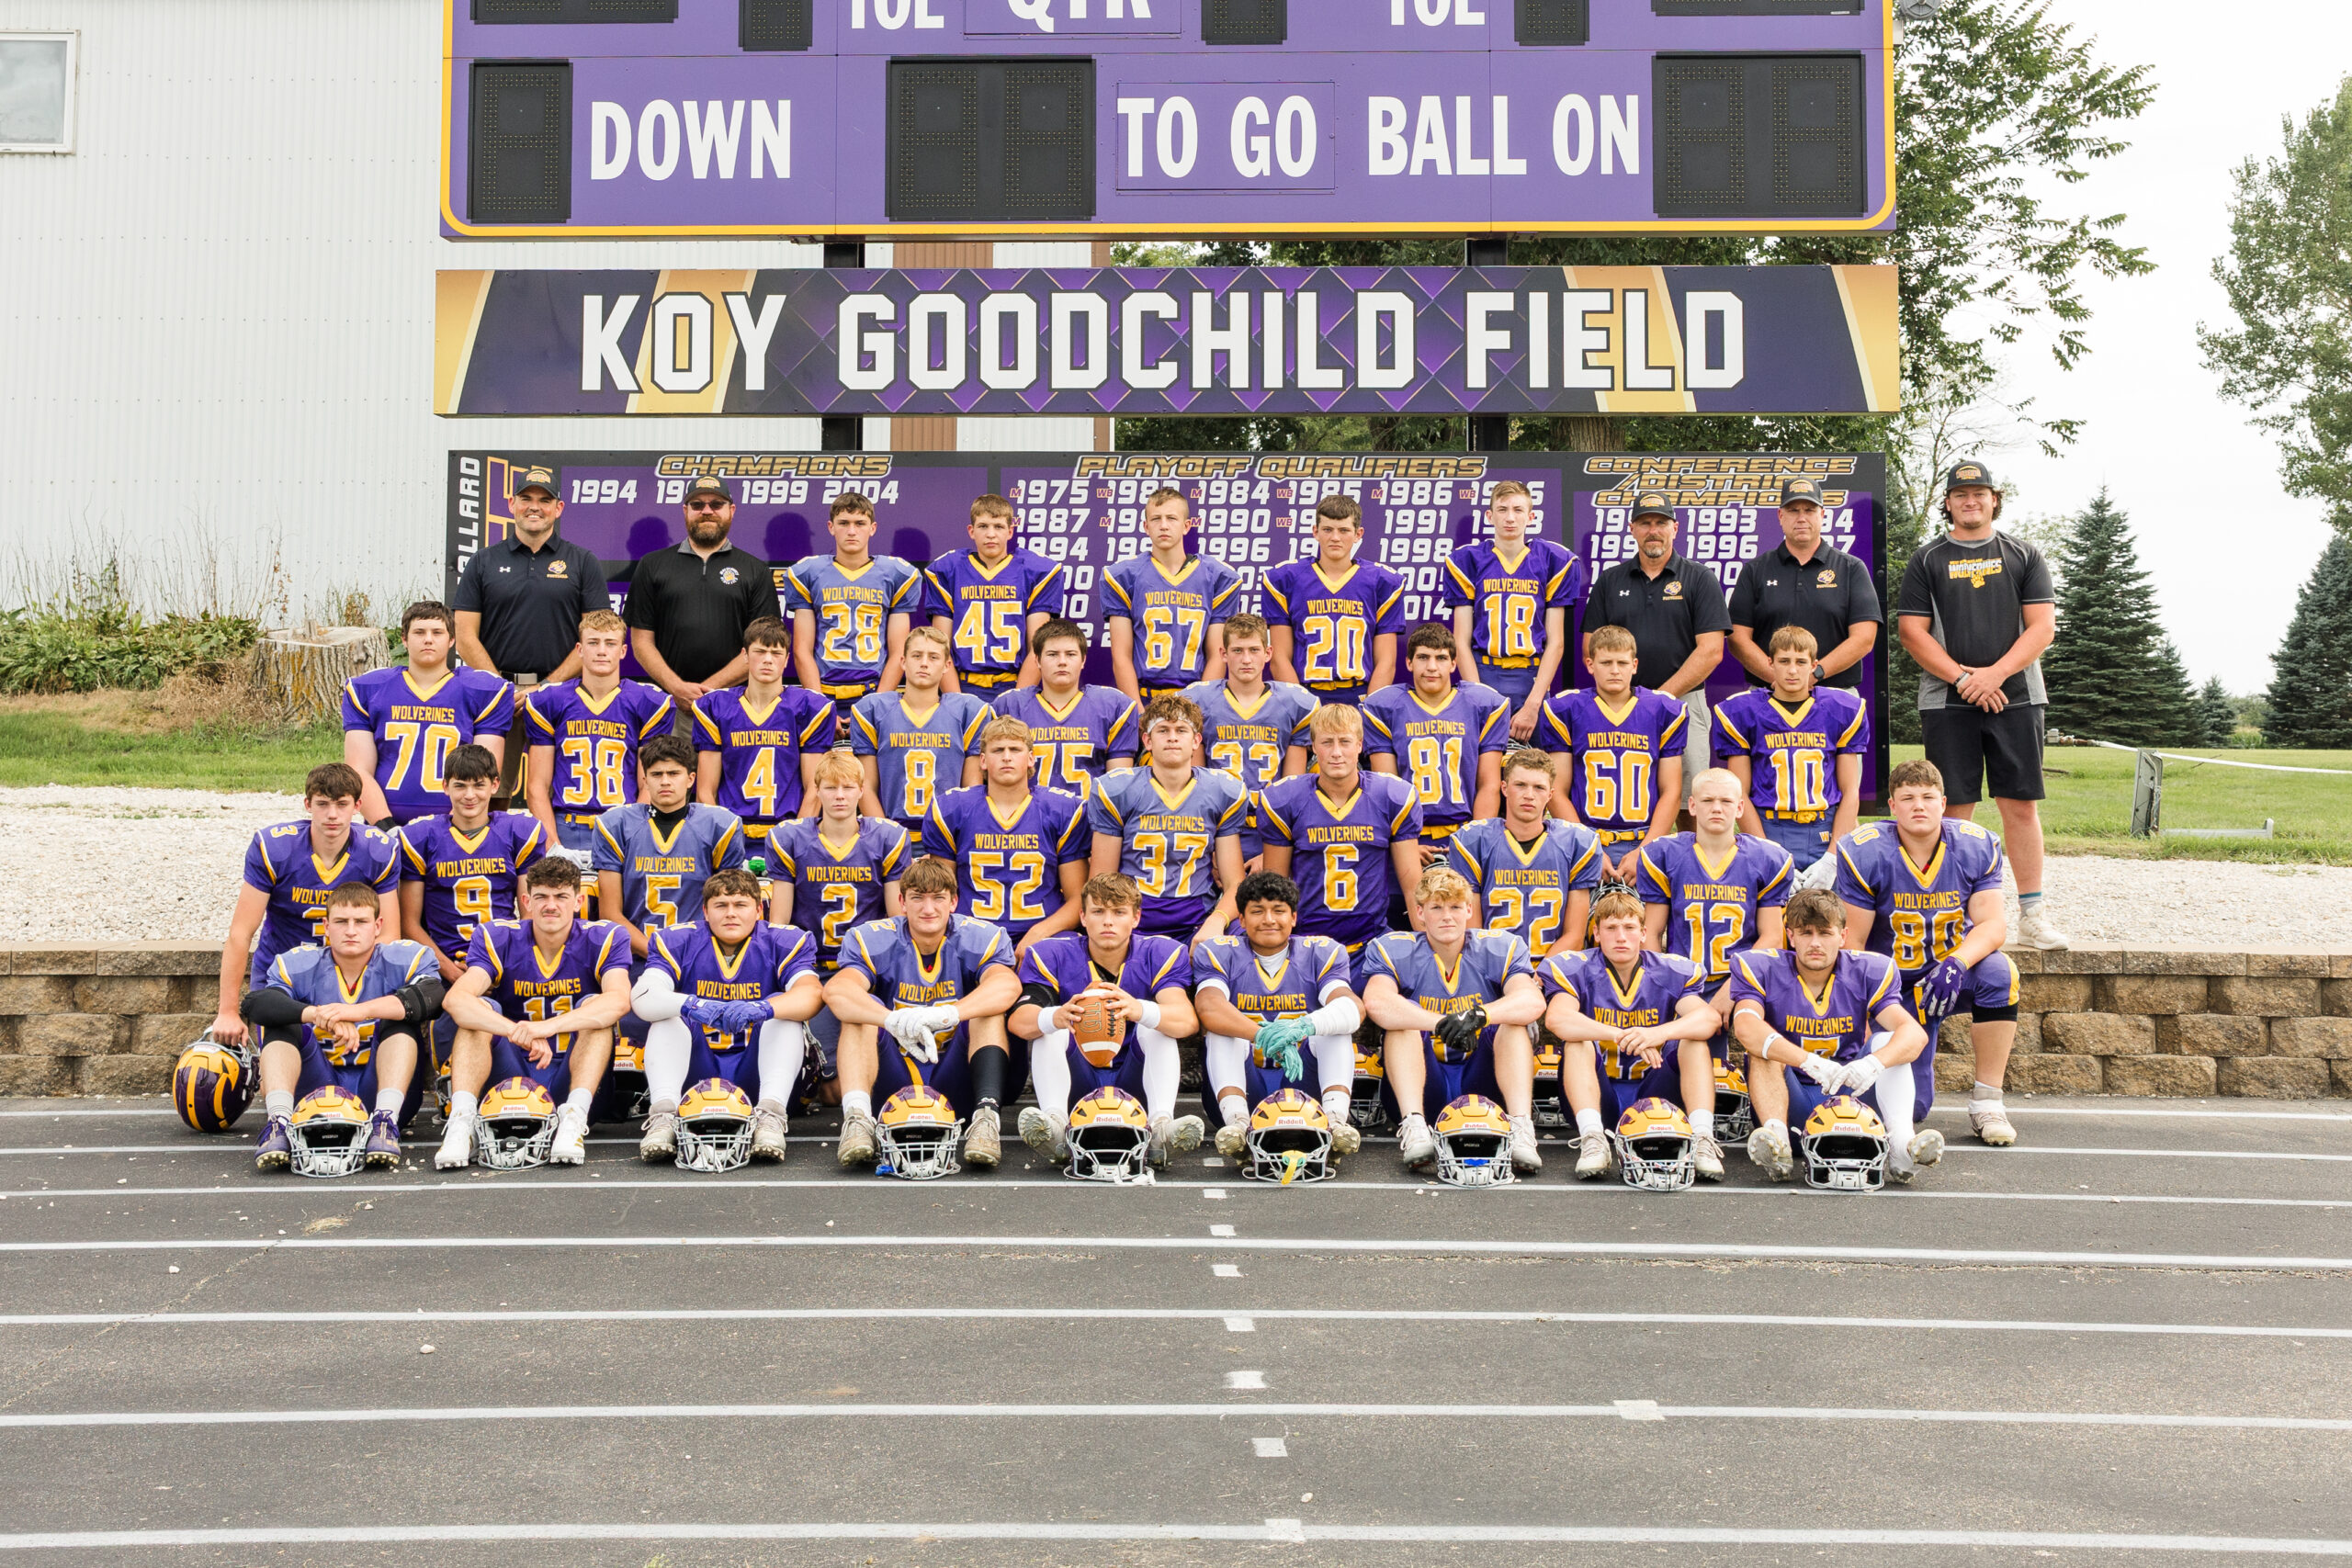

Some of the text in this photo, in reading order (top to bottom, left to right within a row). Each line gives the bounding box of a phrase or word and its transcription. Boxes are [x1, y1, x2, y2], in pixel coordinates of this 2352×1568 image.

[591, 99, 791, 181] DOWN
[1117, 96, 1317, 178] TO GO
[1368, 93, 1639, 175] BALL ON
[581, 289, 1746, 393] KOY GOODCHILD FIELD
[655, 455, 892, 479] CHAMPIONS
[1074, 456, 1488, 481] PLAYOFF QUALIFIERS
[1583, 457, 1857, 474] CONFERENCE
[571, 479, 638, 504] 1994
[741, 480, 808, 504] 1999
[822, 480, 899, 504] 2004
[1017, 479, 1090, 504] 1975
[1198, 480, 1270, 504] 1984
[1379, 480, 1453, 505] 1986
[1017, 508, 1091, 533] 1987
[1198, 509, 1271, 533] 1990
[1385, 510, 1448, 534] 1991
[1687, 509, 1757, 533] 1993
[1198, 537, 1271, 562] 1996
[1379, 538, 1453, 562] 1998
[1590, 535, 1758, 558] 199 1996
[822, 586, 883, 604] WOLVERINES
[961, 585, 1016, 600] WOLVERINES
[1483, 578, 1539, 594] WOLVERINES
[1145, 592, 1203, 607] WOLVERINES
[1306, 599, 1363, 615] WOLVERINES
[1404, 595, 1453, 620] 014
[821, 602, 883, 663] 28
[954, 601, 1023, 664] 45
[1484, 593, 1537, 658] 18
[1143, 606, 1206, 671] 67
[1303, 615, 1368, 681] 20
[391, 705, 455, 724] WOLVERINES
[567, 720, 627, 739] WOLVERINES
[730, 730, 789, 746] WOLVERINES
[1031, 727, 1089, 741] WOLVERINES
[1216, 725, 1278, 741] WOLVERINES
[1405, 719, 1465, 737] WOLVERINES
[889, 732, 951, 749] WOLVERINES
[1588, 732, 1648, 750] WOLVERINES
[1765, 733, 1826, 749] WOLVERINES
[384, 722, 461, 793] 70
[561, 737, 627, 807] 38
[741, 747, 777, 817] 4
[1034, 743, 1094, 801] 75
[1408, 737, 1465, 805] 81
[1770, 749, 1829, 811] 10
[903, 749, 936, 818] 8
[1582, 749, 1653, 822] 60
[1139, 815, 1204, 832] WOLVERINES
[1307, 826, 1374, 843] WOLVERINES
[975, 833, 1039, 850] WOLVERINES
[436, 857, 506, 877] WOLVERINES
[635, 856, 695, 873] WOLVERINES
[807, 866, 872, 883] WOLVERINES
[1132, 832, 1209, 897] 37
[969, 852, 1046, 920] 52
[1323, 843, 1359, 911] 6
[1495, 869, 1559, 886] WOLVERINES
[291, 886, 334, 906] WOLVE
[1683, 884, 1747, 902] WOLVERINES
[1894, 890, 1961, 909] WOLVERINES
[453, 875, 492, 942] 9
[644, 874, 683, 937] 5
[821, 884, 858, 948] 2
[1487, 887, 1564, 957] 22
[1684, 902, 1746, 975] 12
[1889, 908, 1966, 972] 80
[514, 977, 582, 996] WOLVERINES
[696, 979, 762, 1000] WOLVERINES
[899, 980, 956, 1002] WOLVERINES
[1237, 993, 1306, 1010] WOLVERINES
[1419, 993, 1483, 1014] WOLVERINES
[1594, 1007, 1659, 1027] WOLVERINES
[1785, 1015, 1854, 1036] WOLVERINES
